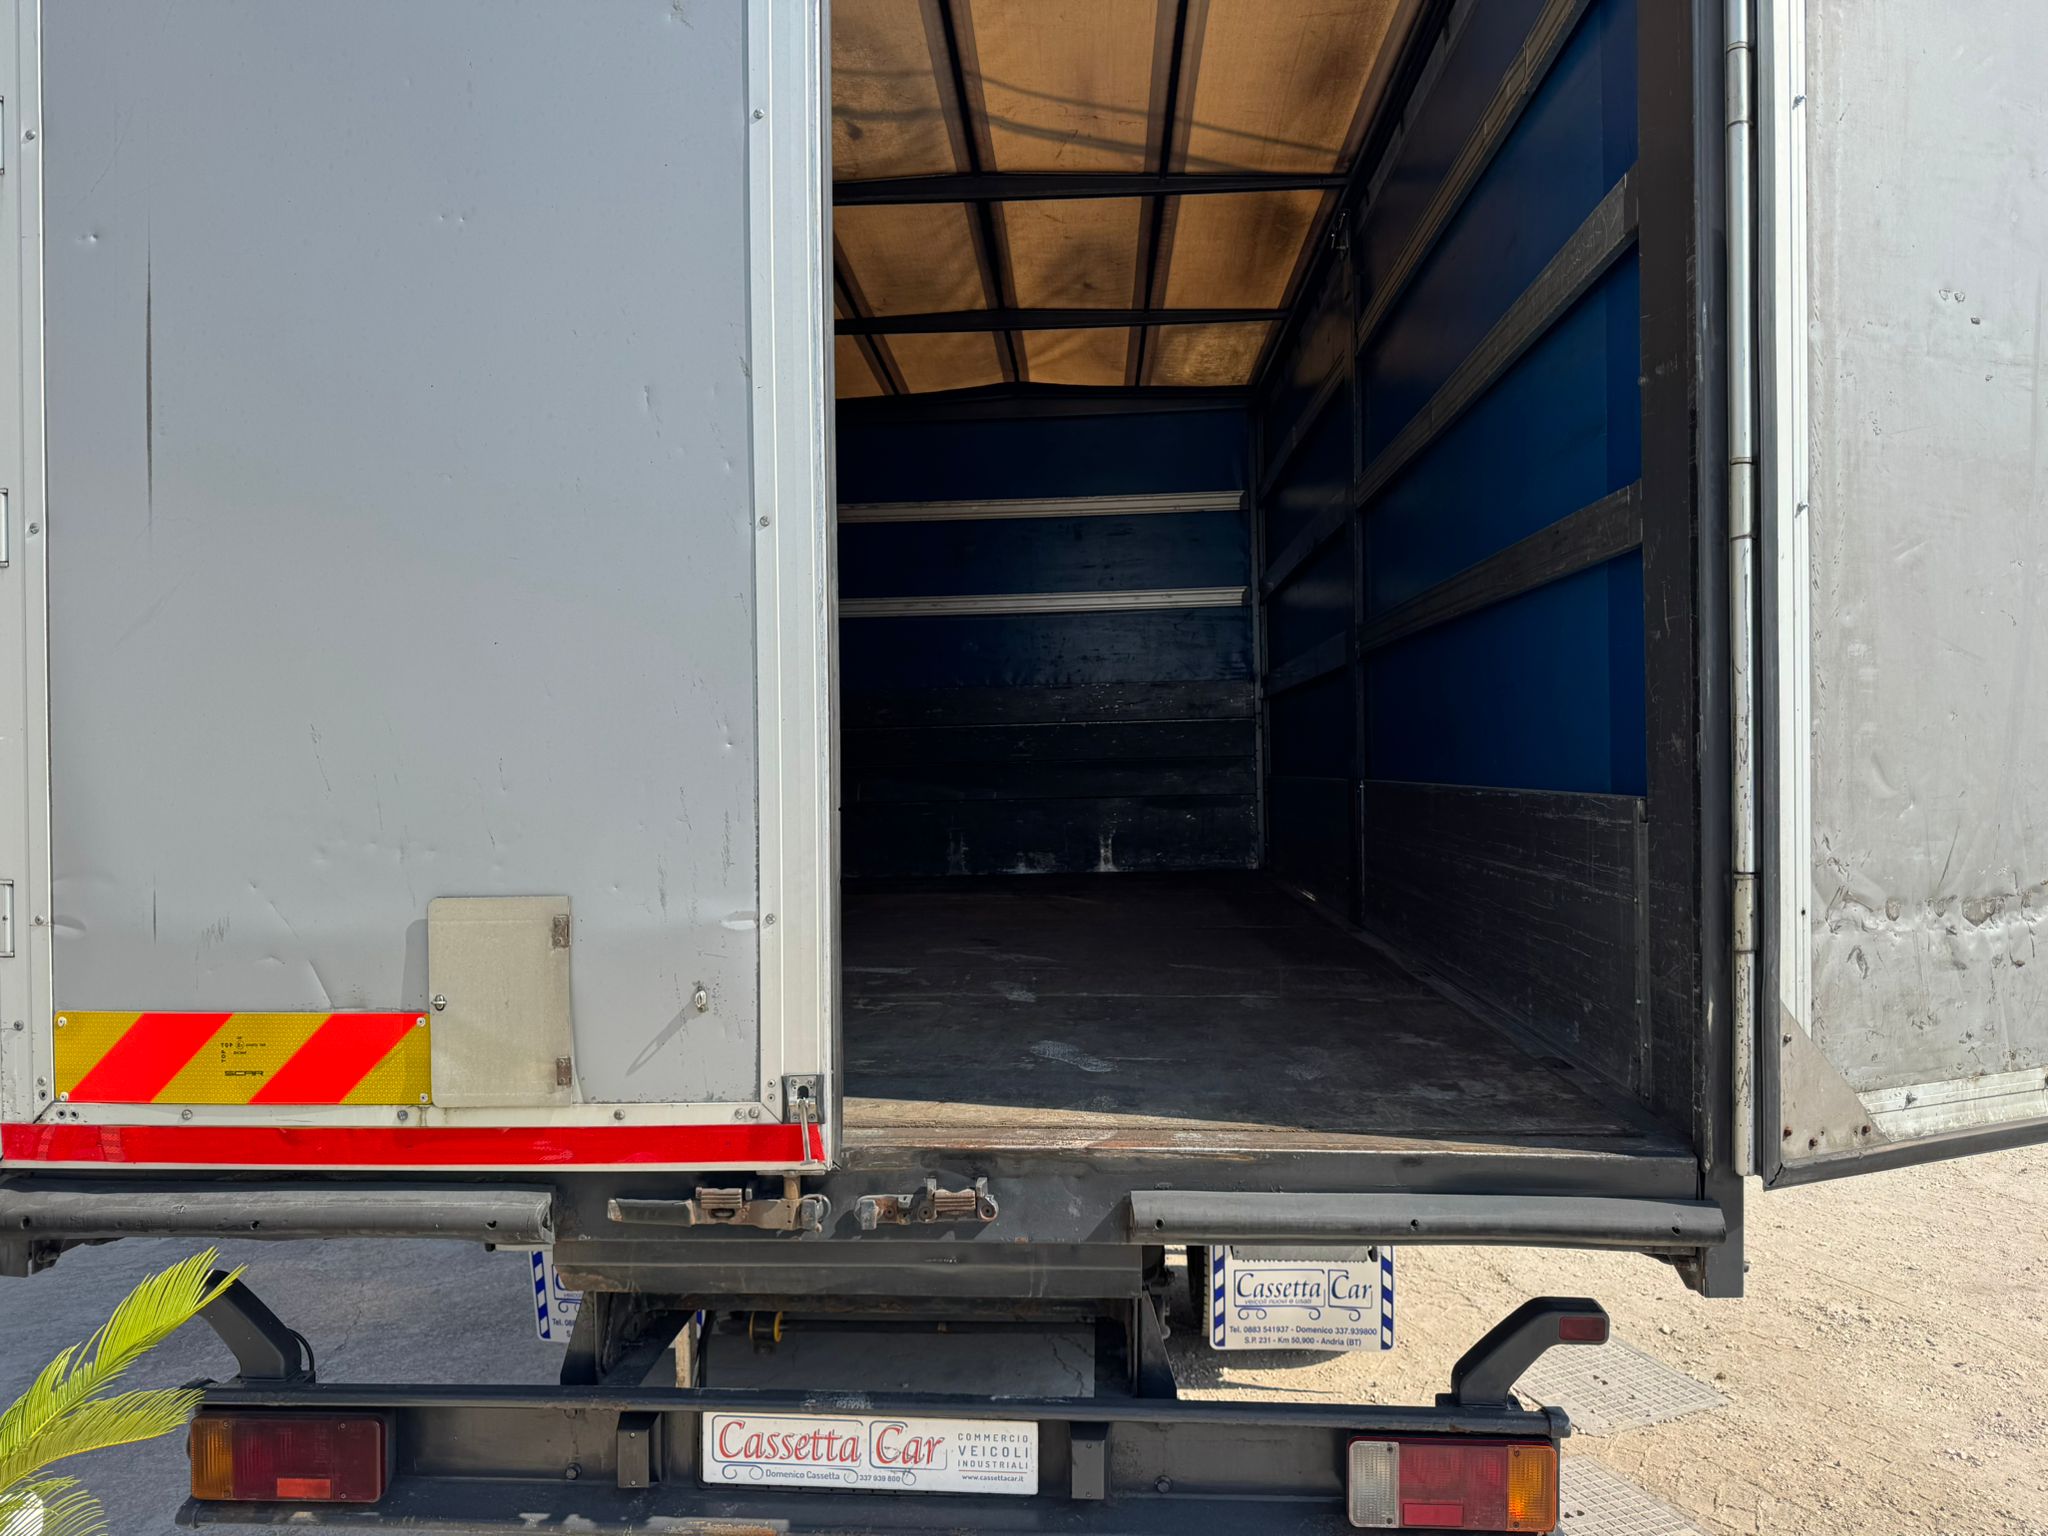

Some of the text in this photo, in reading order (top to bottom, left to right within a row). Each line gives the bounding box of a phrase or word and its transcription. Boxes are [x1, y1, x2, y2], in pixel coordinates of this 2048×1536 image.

[1236, 1272, 1372, 1300] Cassetta Car
[1229, 1325, 1241, 1333] Tel.
[1295, 1325, 1333, 1334] Domenico
[1277, 1336, 1289, 1344] Km
[1321, 1338, 1344, 1346] Andria
[1346, 1338, 1362, 1347] (BT)
[718, 1420, 945, 1465] Cassetta Car
[957, 1432, 1029, 1443] COMMERCIO
[957, 1445, 1029, 1458] VEICOLI
[957, 1459, 1028, 1469] INDUSTRIALI
[765, 1469, 805, 1479] Domenico
[806, 1470, 840, 1481] Cassetta
[961, 1474, 1024, 1482] www.cassettacar.it
